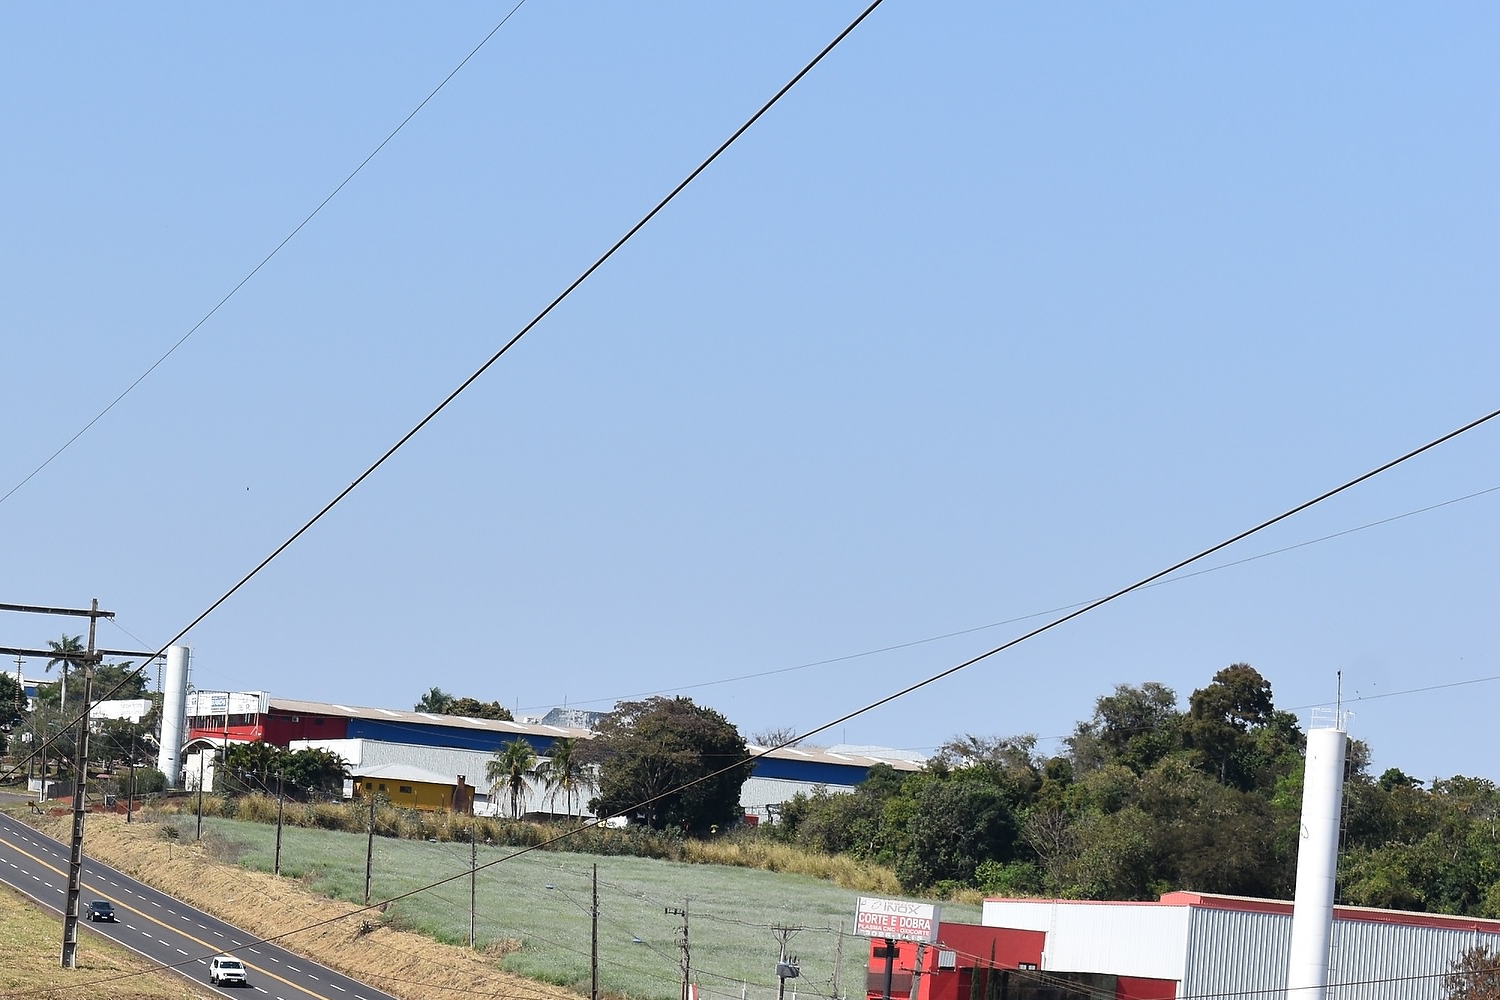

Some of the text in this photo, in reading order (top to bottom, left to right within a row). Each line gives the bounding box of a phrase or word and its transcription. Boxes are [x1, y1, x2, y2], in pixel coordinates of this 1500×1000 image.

[883, 901, 921, 915] INOX
[858, 912, 931, 931] CORTE E DOBRA
[858, 923, 882, 931] PLASMA
